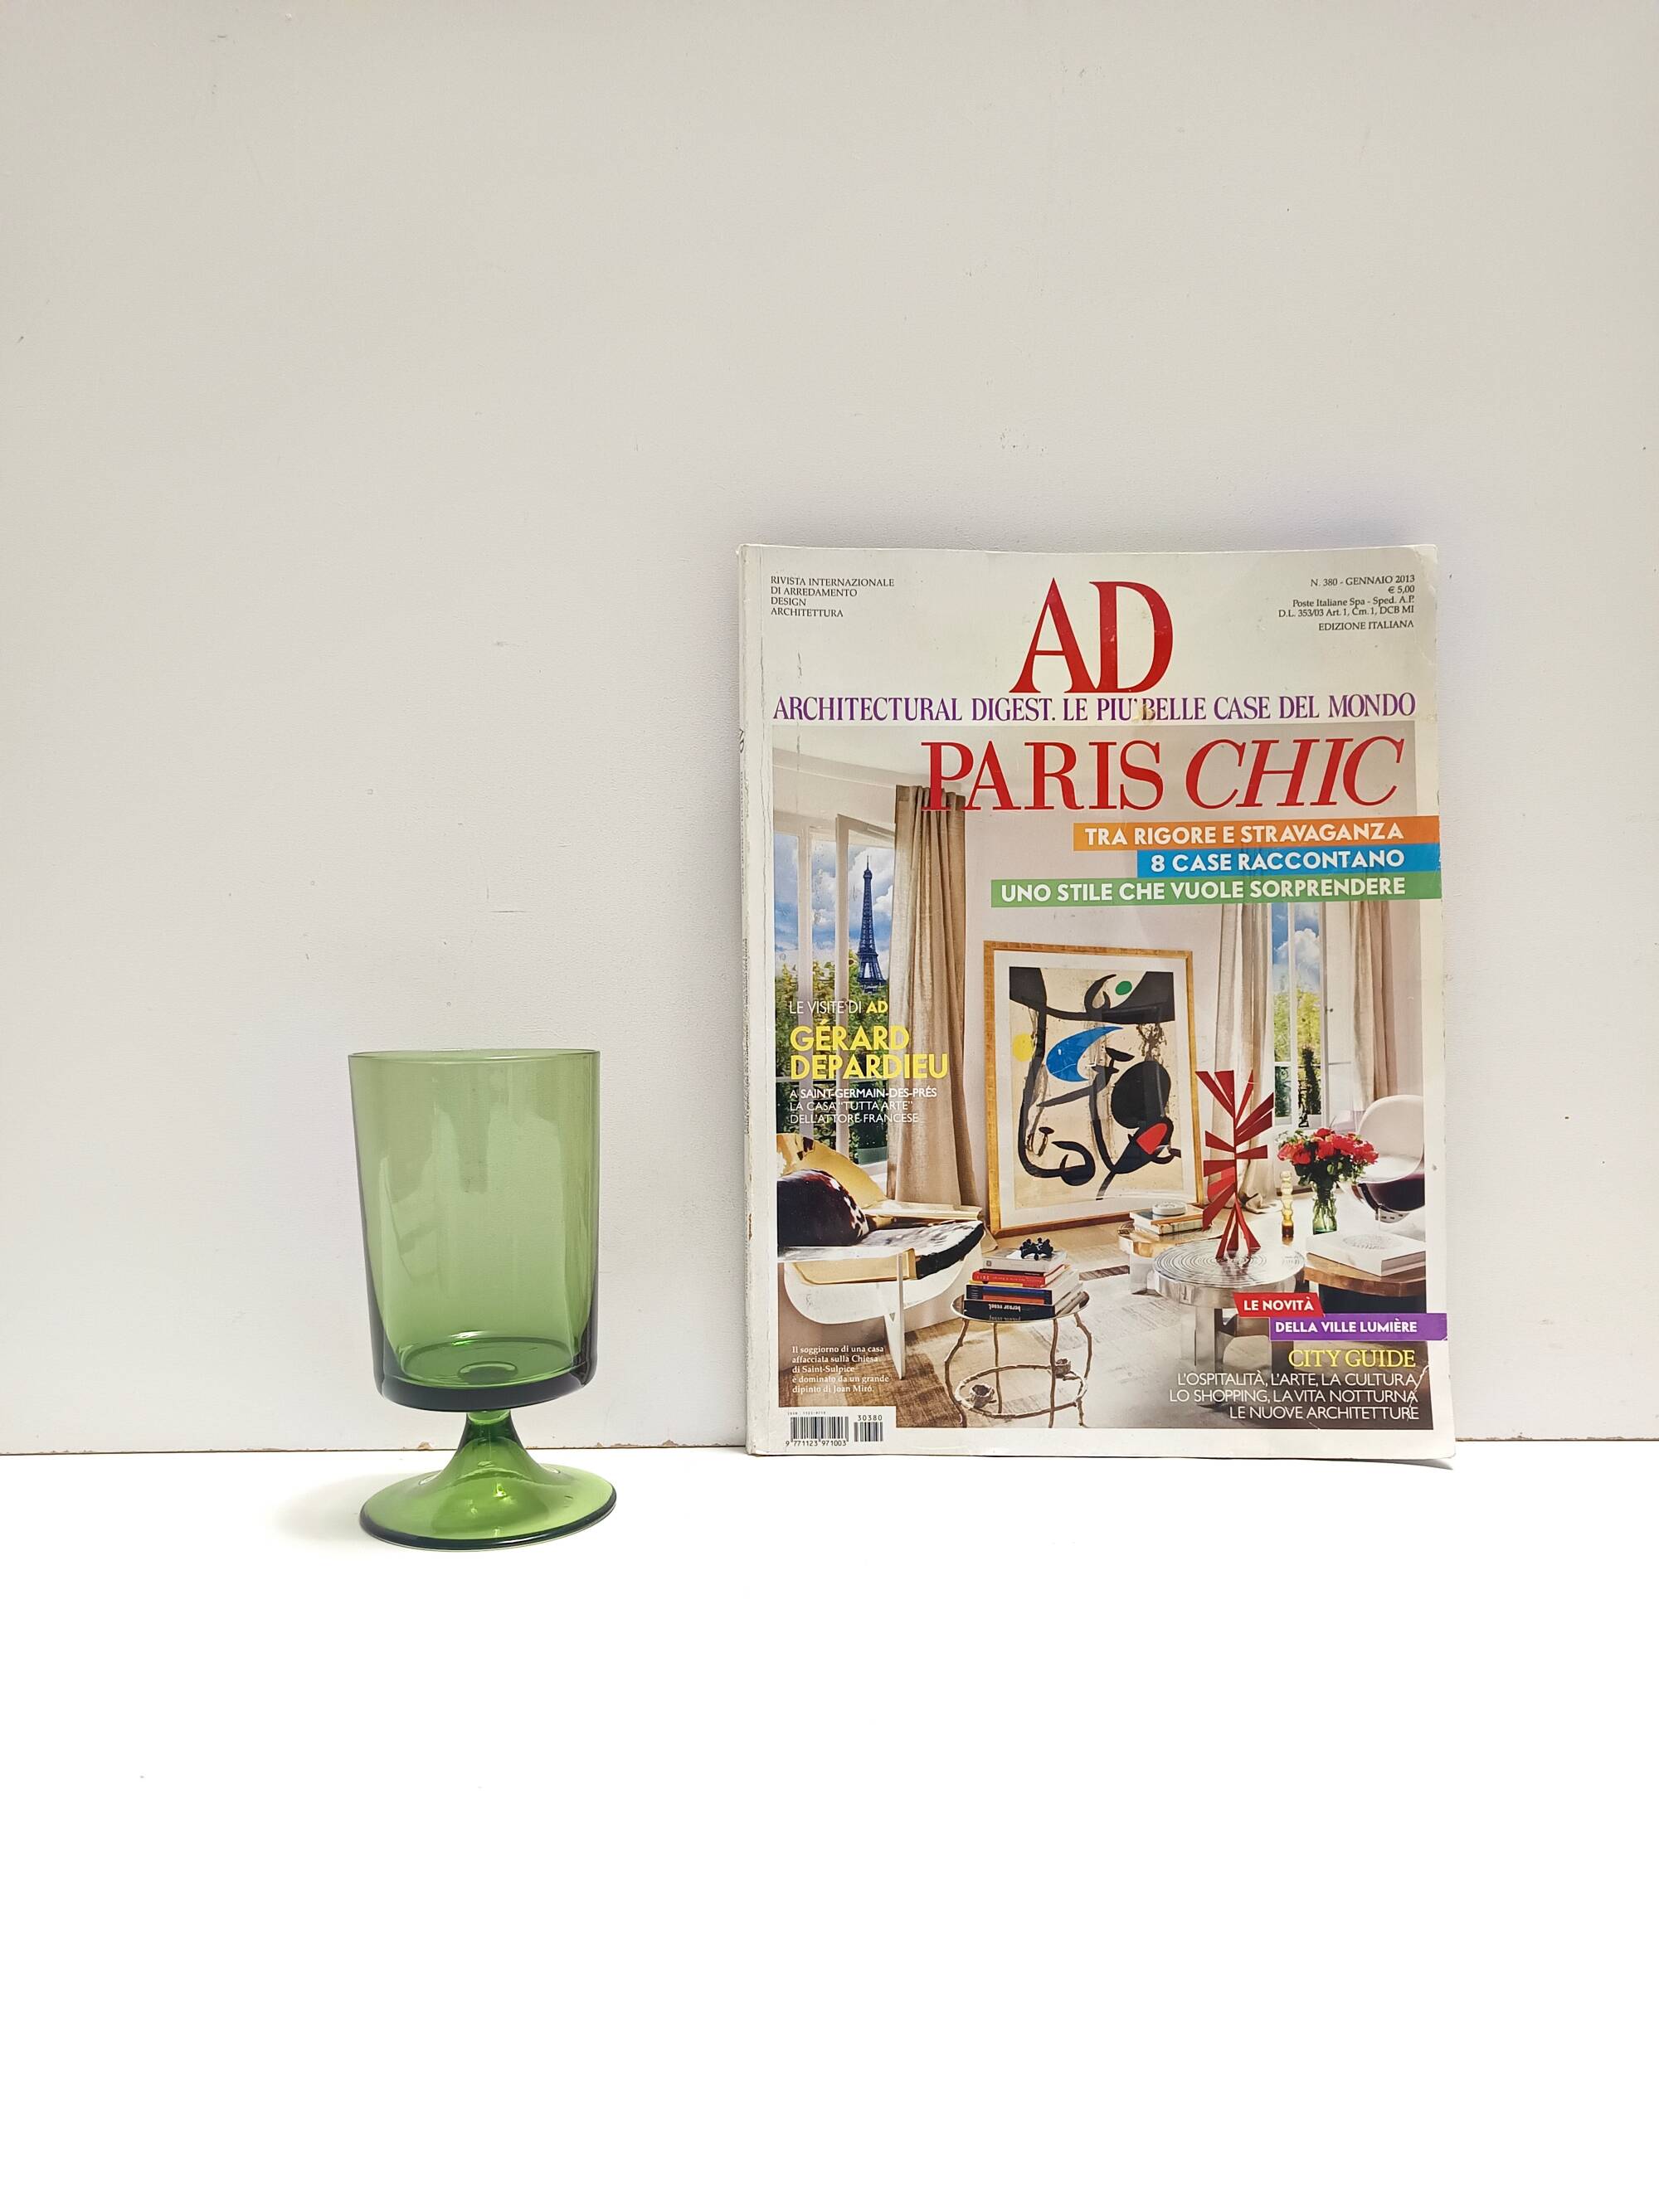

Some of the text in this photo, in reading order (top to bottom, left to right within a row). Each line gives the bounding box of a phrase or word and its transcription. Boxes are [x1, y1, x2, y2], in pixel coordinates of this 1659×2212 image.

[771, 576, 895, 587] RIVISTA INTERNAZIONALE
[1311, 579, 1321, 587] N.
[1323, 578, 1338, 586] 380
[1345, 576, 1393, 586] GENNAIO
[1395, 575, 1415, 584] 2013
[771, 586, 858, 597] DI ARREDAMENTO
[1397, 586, 1415, 595] 5,00
[771, 597, 806, 606] DESIGN
[1292, 599, 1314, 608] Poste
[1316, 598, 1348, 606] Italiane
[1350, 598, 1365, 609] Spa
[1373, 597, 1396, 606] Sped.
[1399, 596, 1414, 604] A.P.
[771, 607, 844, 617] ARCHITETTURA
[1278, 609, 1296, 618] D.L.
[1297, 608, 1324, 617] 353/03
[1379, 605, 1400, 615] DCB
[1402, 605, 1414, 614] MI
[1319, 620, 1413, 631] EDIZIONE ITALIANA
[1009, 577, 1174, 693] AD
[772, 692, 1416, 722] ARCHITECTURAL DIGEST. LE PIU' BELLE CASE DEL MONDO
[921, 736, 1404, 810] PARIS CHIC
[1084, 822, 1404, 846] TRA RIGORE E STRAVAGANZA
[1151, 849, 1404, 872] 8 CASE RACCONTANO
[1001, 877, 1405, 902] UNO STILE CHE VUOLE SORPRENDERE
[790, 1001, 888, 1014] LE VISITE DI AD
[790, 1018, 910, 1052] GÉRARD
[790, 1053, 949, 1080] DEPARDIEU
[790, 1087, 937, 1099] A SAINT-GERMAIN-DES-PRÉS
[790, 1102, 803, 1111] LA
[807, 1102, 836, 1111] CASA
[790, 1113, 918, 1124] DELL'ATTORE FRANCESE
[1243, 1296, 1315, 1311] LE NOVITÀ
[1275, 1317, 1418, 1334] DELLA VILLE LUMIÈRE
[791, 1345, 799, 1354] Il
[800, 1345, 839, 1354] soggiorno
[851, 1354, 878, 1363] Chiesa
[1288, 1349, 1416, 1369] CITY GUIDE
[802, 1365, 855, 1375] Saint-Sulpice
[862, 1375, 889, 1383] grande
[1177, 1370, 1416, 1388] L'OSPITALITÀ, L'ARTE, LA CULTURA
[792, 1386, 821, 1394] dipinto
[833, 1386, 850, 1394] Joan
[1170, 1389, 1418, 1404] LO SHOPPING, LA VITA NOTTURNA
[1229, 1406, 1419, 1420] LE NUOVE ARCHITETTURE
